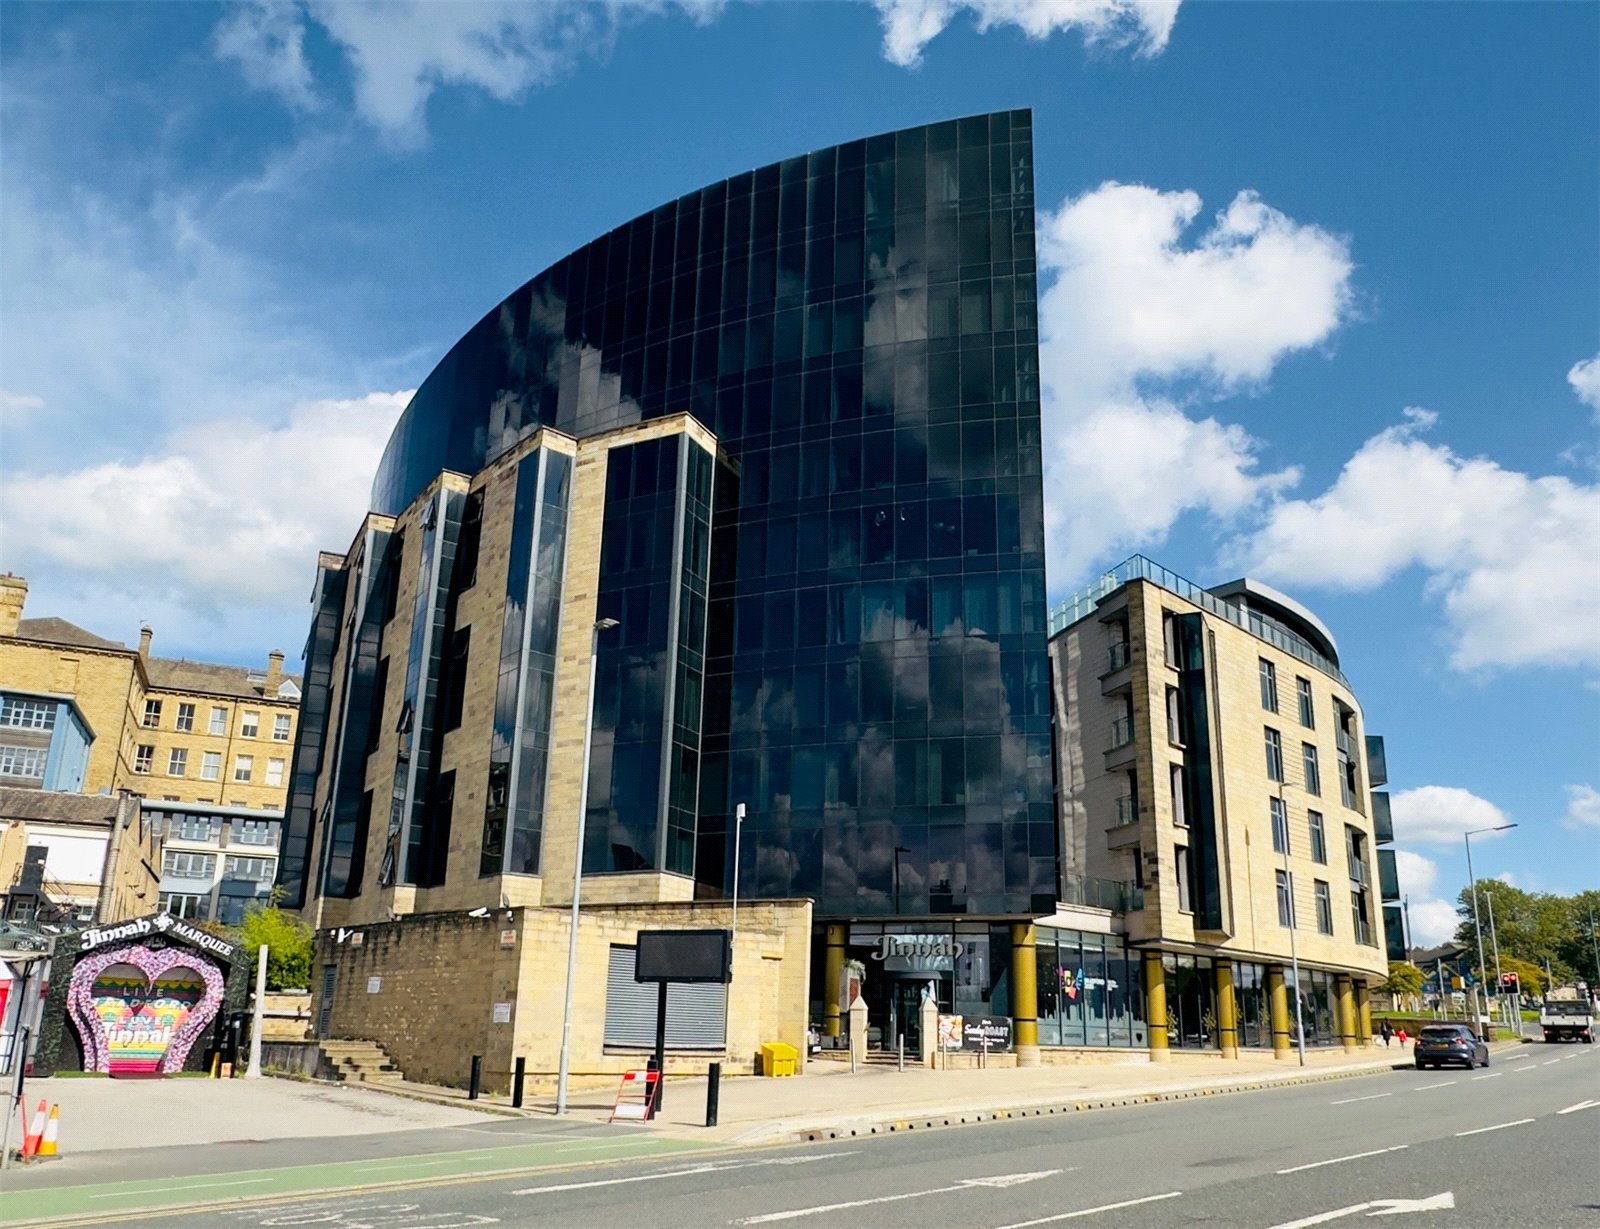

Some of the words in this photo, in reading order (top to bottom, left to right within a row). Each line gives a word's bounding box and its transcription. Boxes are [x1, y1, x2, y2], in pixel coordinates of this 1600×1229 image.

[81, 918, 151, 950] Jinnah
[173, 922, 234, 956] MARQUEE
[871, 935, 964, 967] Jinnah
[123, 987, 164, 997] LIVE
[119, 1016, 162, 1025] LOVE
